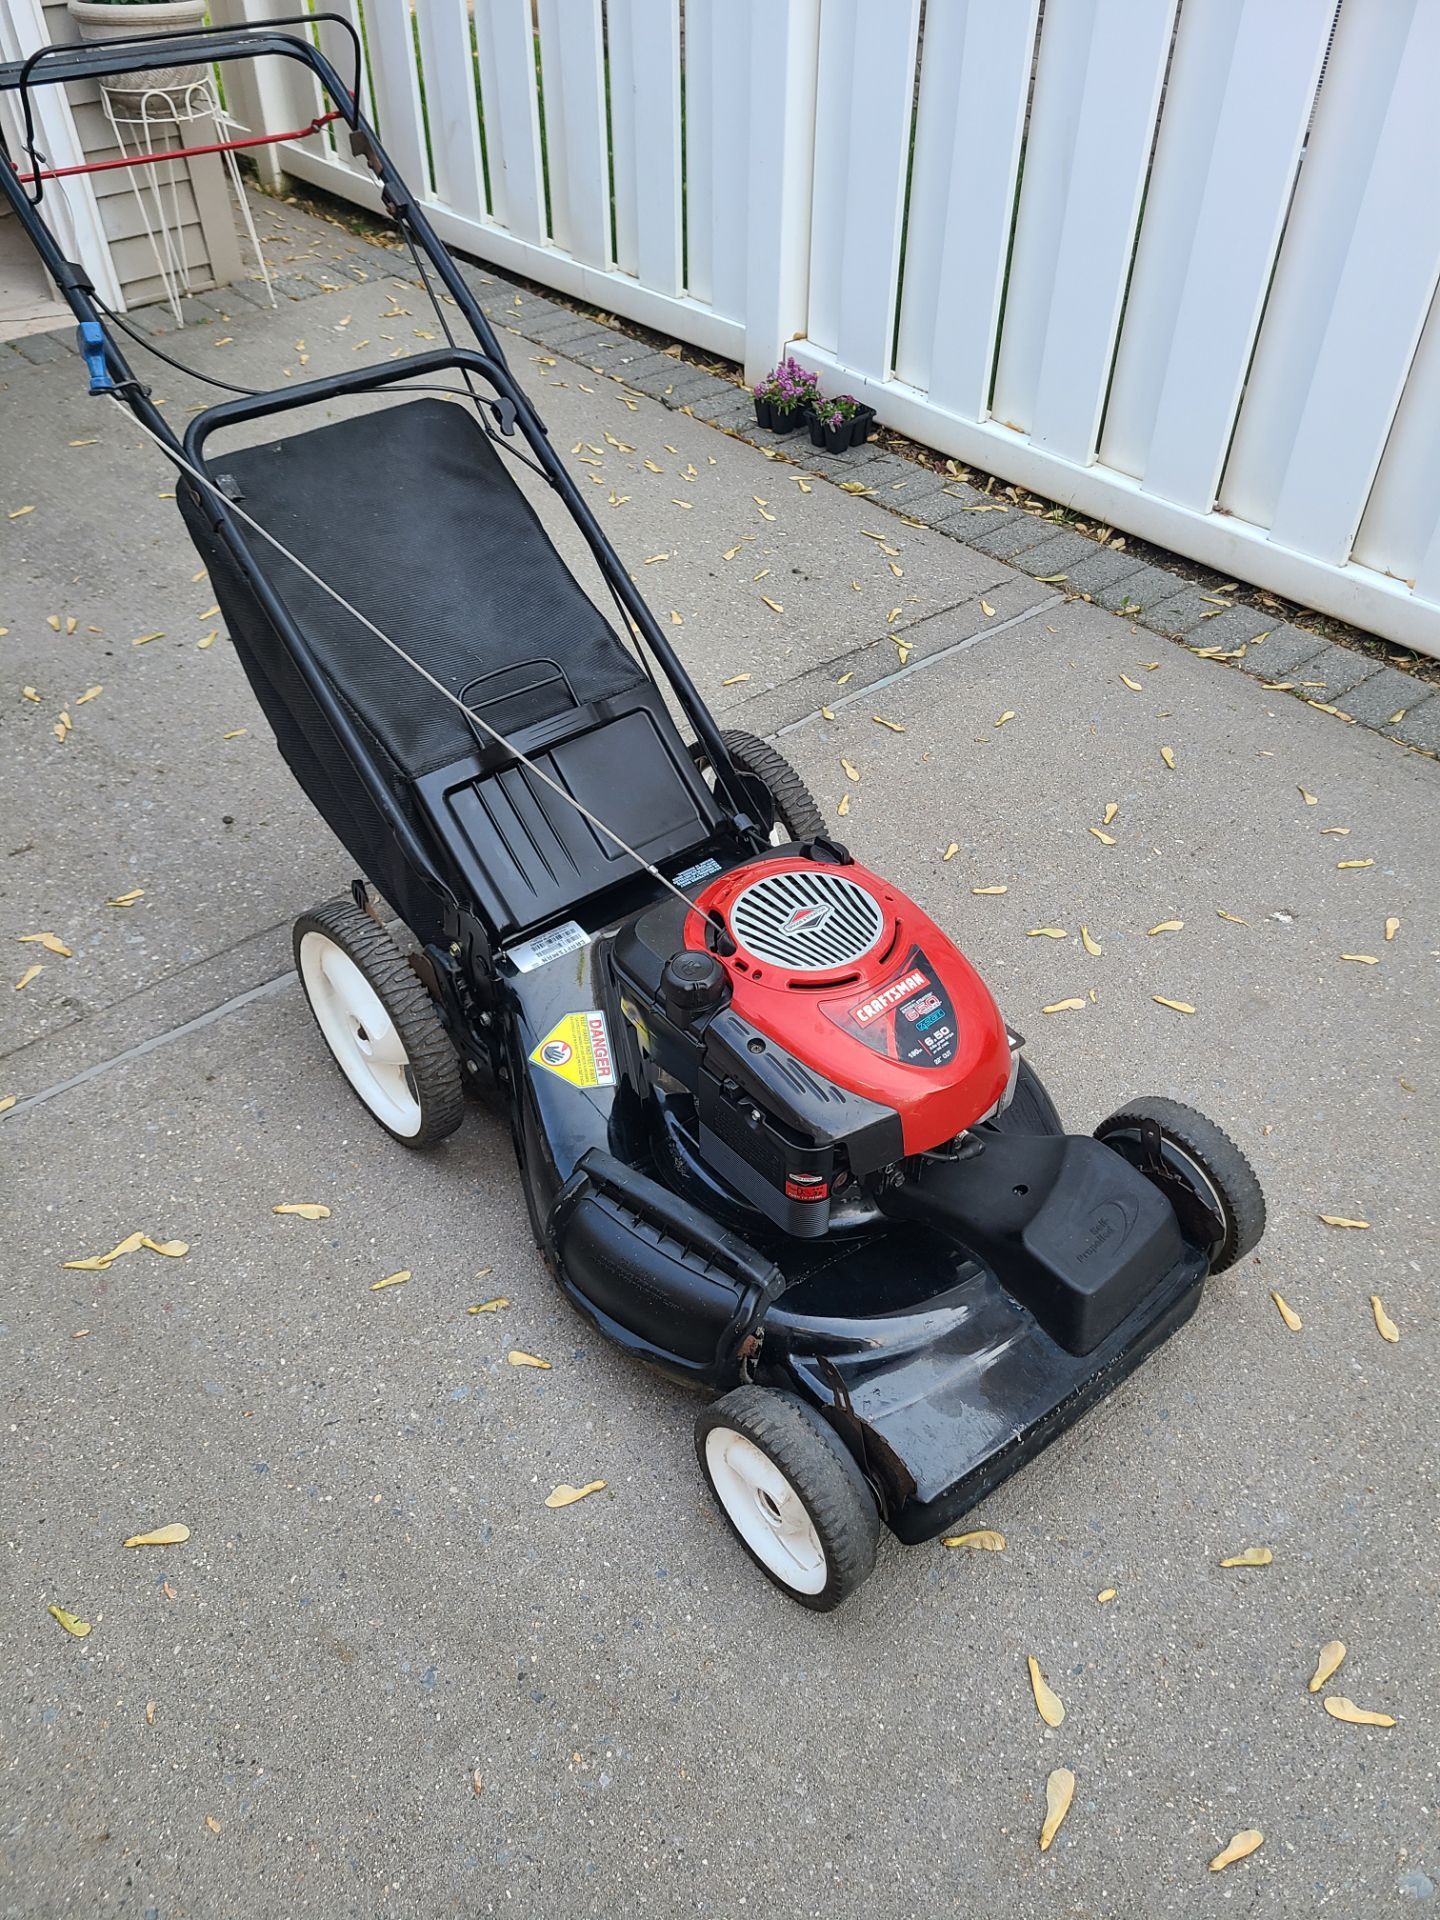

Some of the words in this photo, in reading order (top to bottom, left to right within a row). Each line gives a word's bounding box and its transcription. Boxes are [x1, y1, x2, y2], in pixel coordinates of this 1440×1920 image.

[856, 972, 925, 1022] CRAFTSMAN
[588, 1019, 612, 1077] DANGER
[924, 1026, 950, 1047] 6.50
